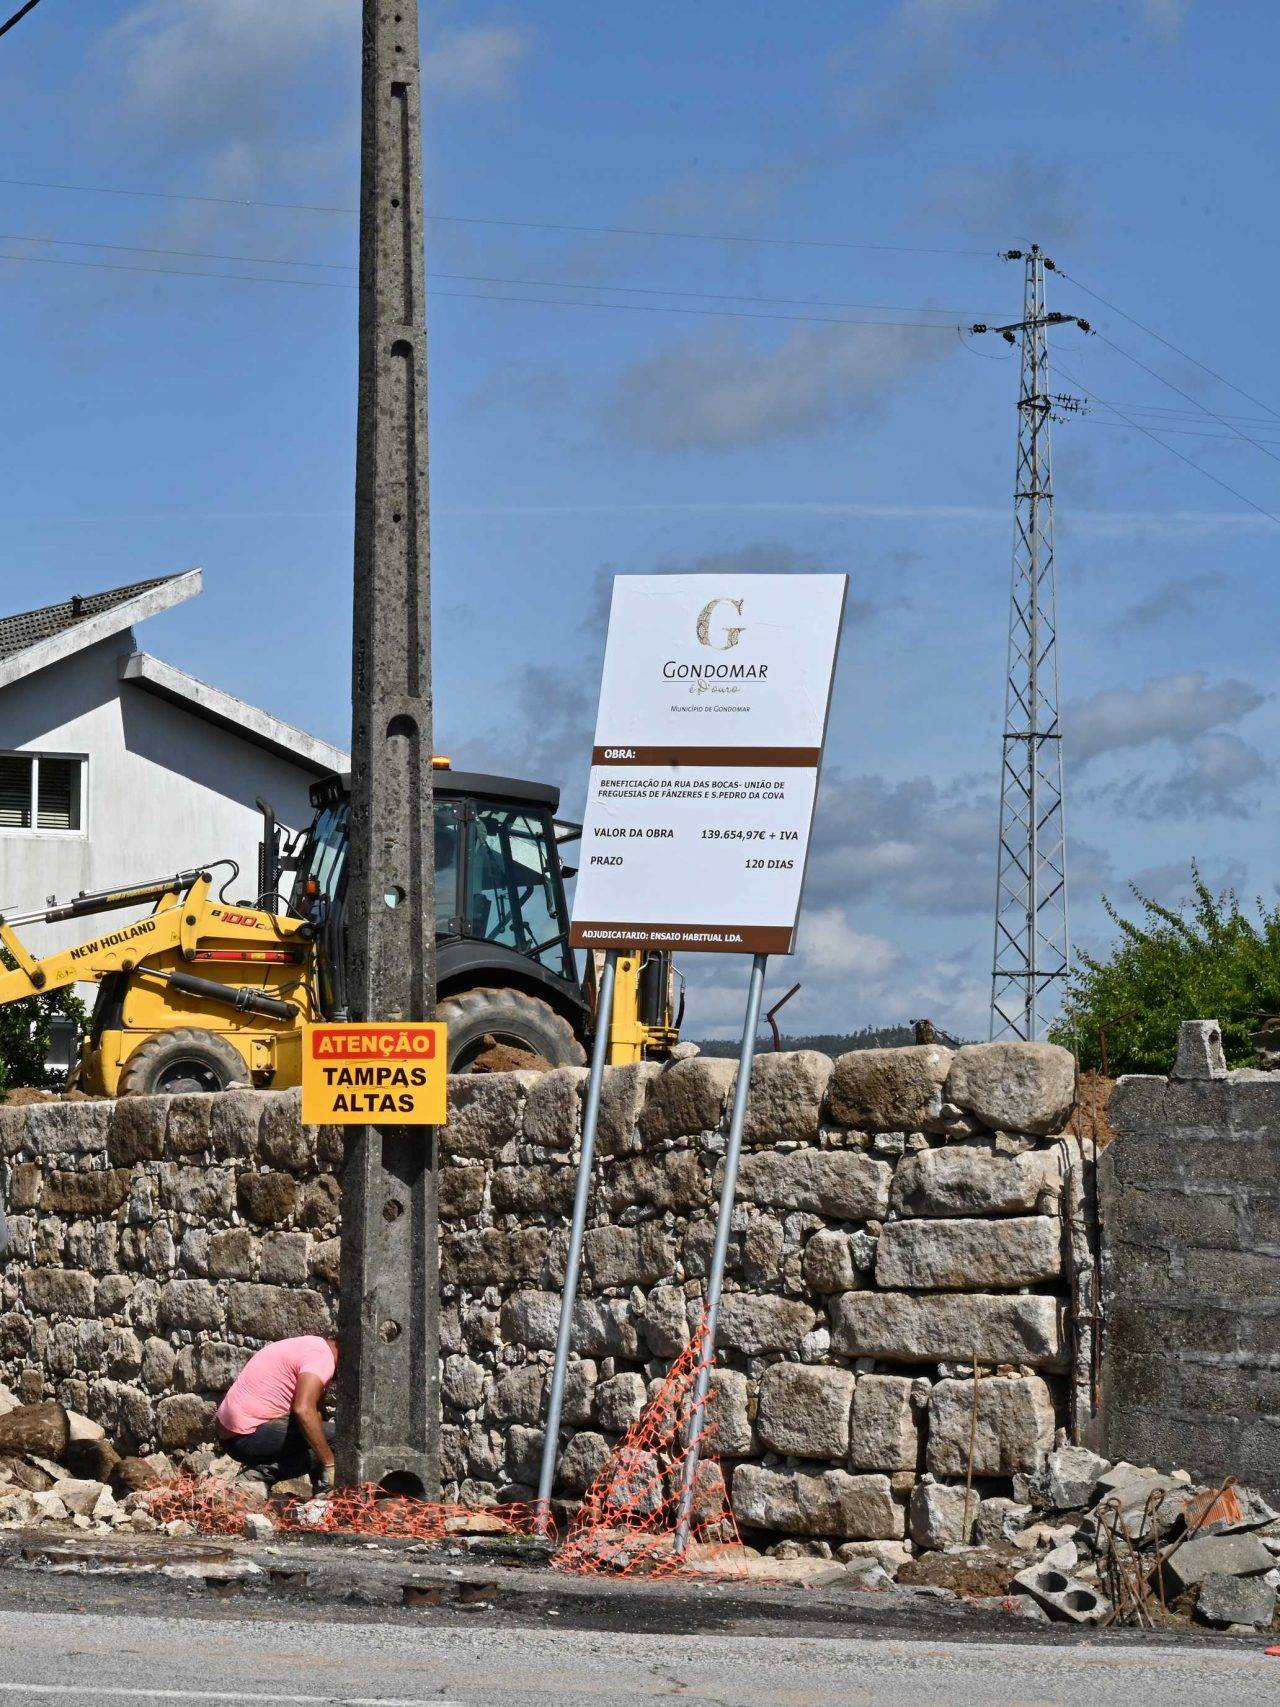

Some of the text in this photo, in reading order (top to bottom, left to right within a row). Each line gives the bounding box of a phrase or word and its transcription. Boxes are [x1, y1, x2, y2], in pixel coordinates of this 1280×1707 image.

[696, 598, 746, 650] G
[663, 660, 768, 678] GONDOMAR
[604, 748, 636, 759] OBRA:
[600, 778, 660, 789] BENEFICIAÇÃO
[661, 780, 672, 788] DA
[674, 780, 691, 788] RUA
[693, 780, 710, 788] DAS
[744, 779, 772, 789] UNIÃO
[773, 781, 785, 789] DE
[598, 790, 647, 798] FREGUESIAS
[648, 790, 660, 798] DE
[661, 788, 703, 798] FÂNZERES
[711, 791, 747, 799] S.PEDRO
[762, 791, 785, 799] COVA
[594, 828, 627, 838] VALOR
[629, 828, 643, 838] DA
[646, 829, 674, 838] OBRA
[701, 829, 766, 842] 139.654,97€
[780, 831, 799, 840] IVA
[590, 856, 794, 869] PRAZO 120 DIAS
[70, 921, 157, 960] NEW HOLLAND
[582, 930, 744, 942] ADJUDICATARIO: ENSAIO HABITUAL LDA.
[318, 1032, 430, 1057] ATENÇÃO
[323, 1067, 427, 1087] TAMPAS
[332, 1094, 415, 1112] ALTAS
